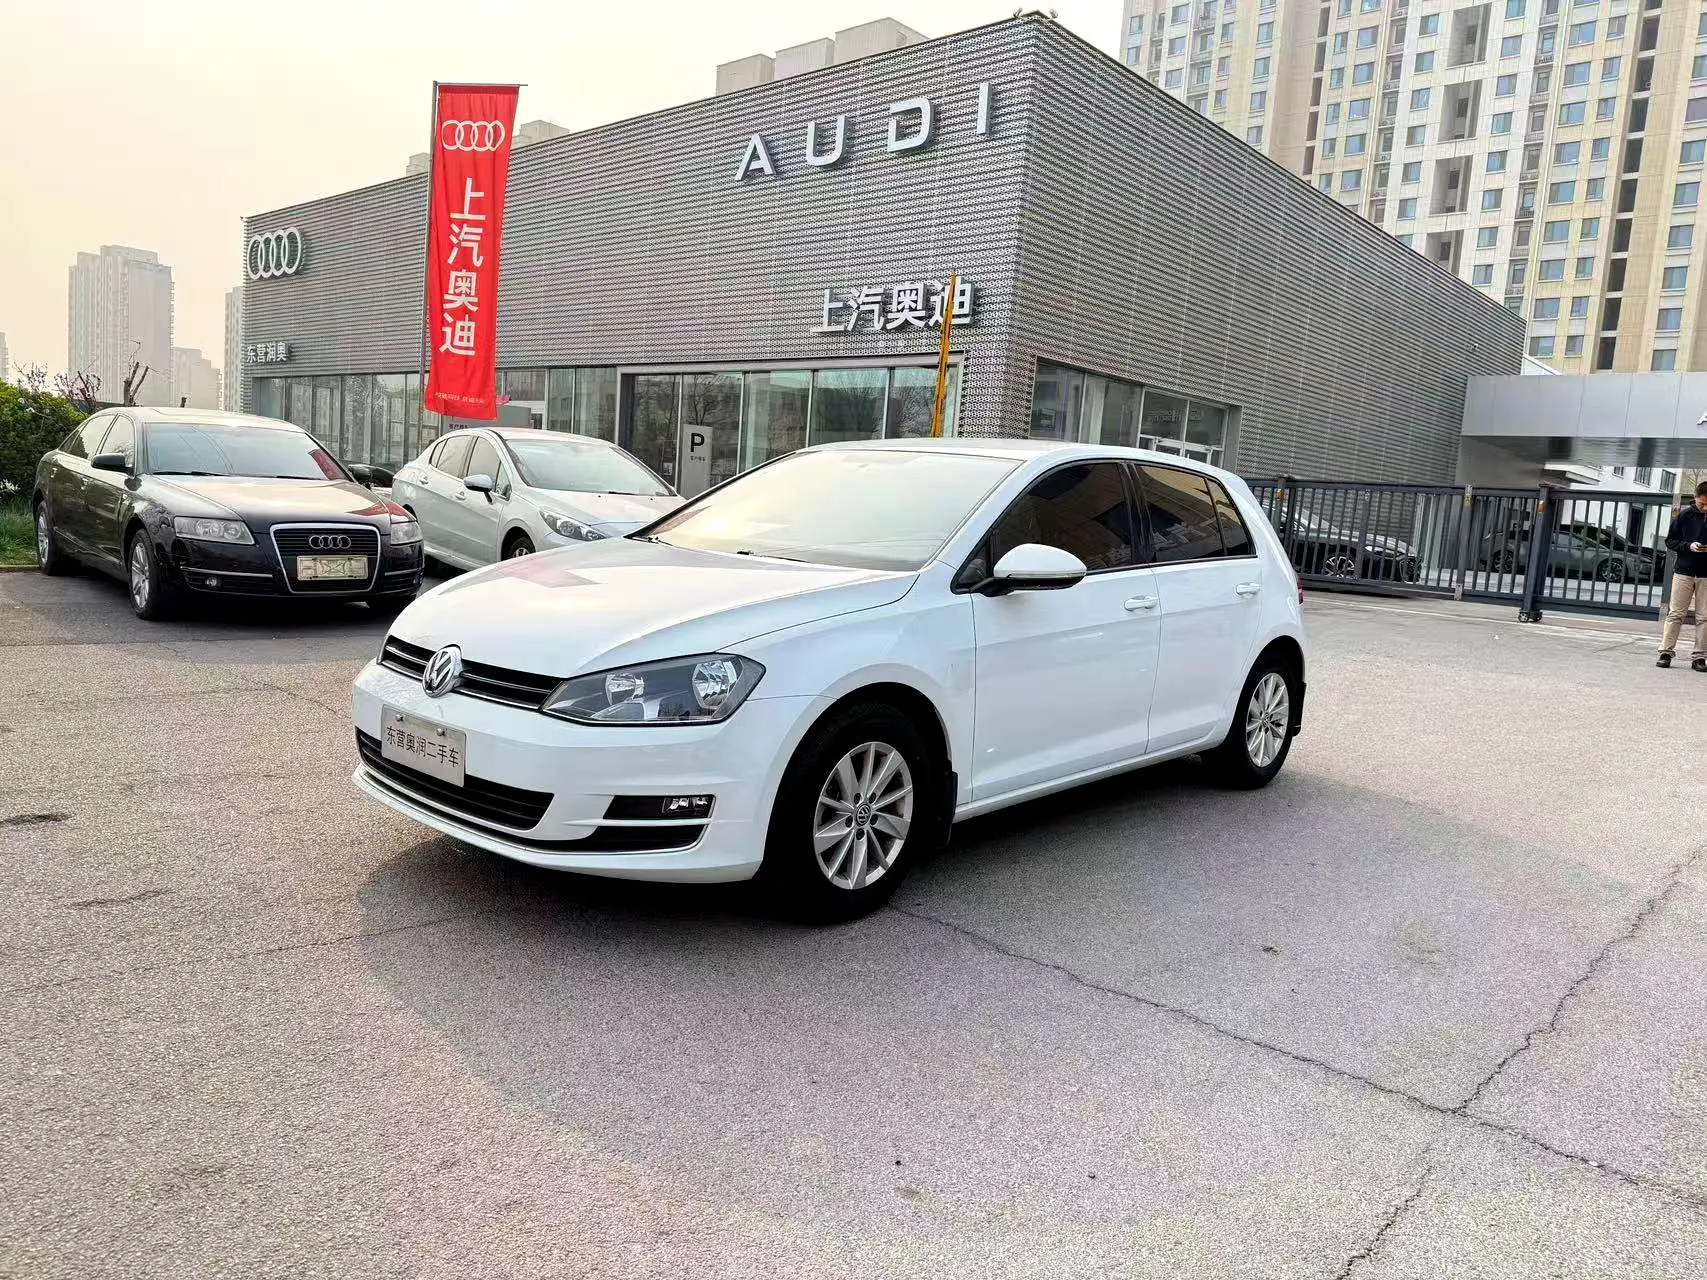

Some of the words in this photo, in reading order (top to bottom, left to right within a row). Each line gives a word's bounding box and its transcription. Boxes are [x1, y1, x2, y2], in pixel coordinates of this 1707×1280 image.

[735, 82, 992, 181] AUDI
[439, 177, 487, 356] 上汽奥迪
[812, 276, 975, 333] 上汽奥迪
[246, 341, 287, 363] 东营润奥
[690, 432, 705, 452] P
[386, 725, 459, 768] 东营奥润二手车
